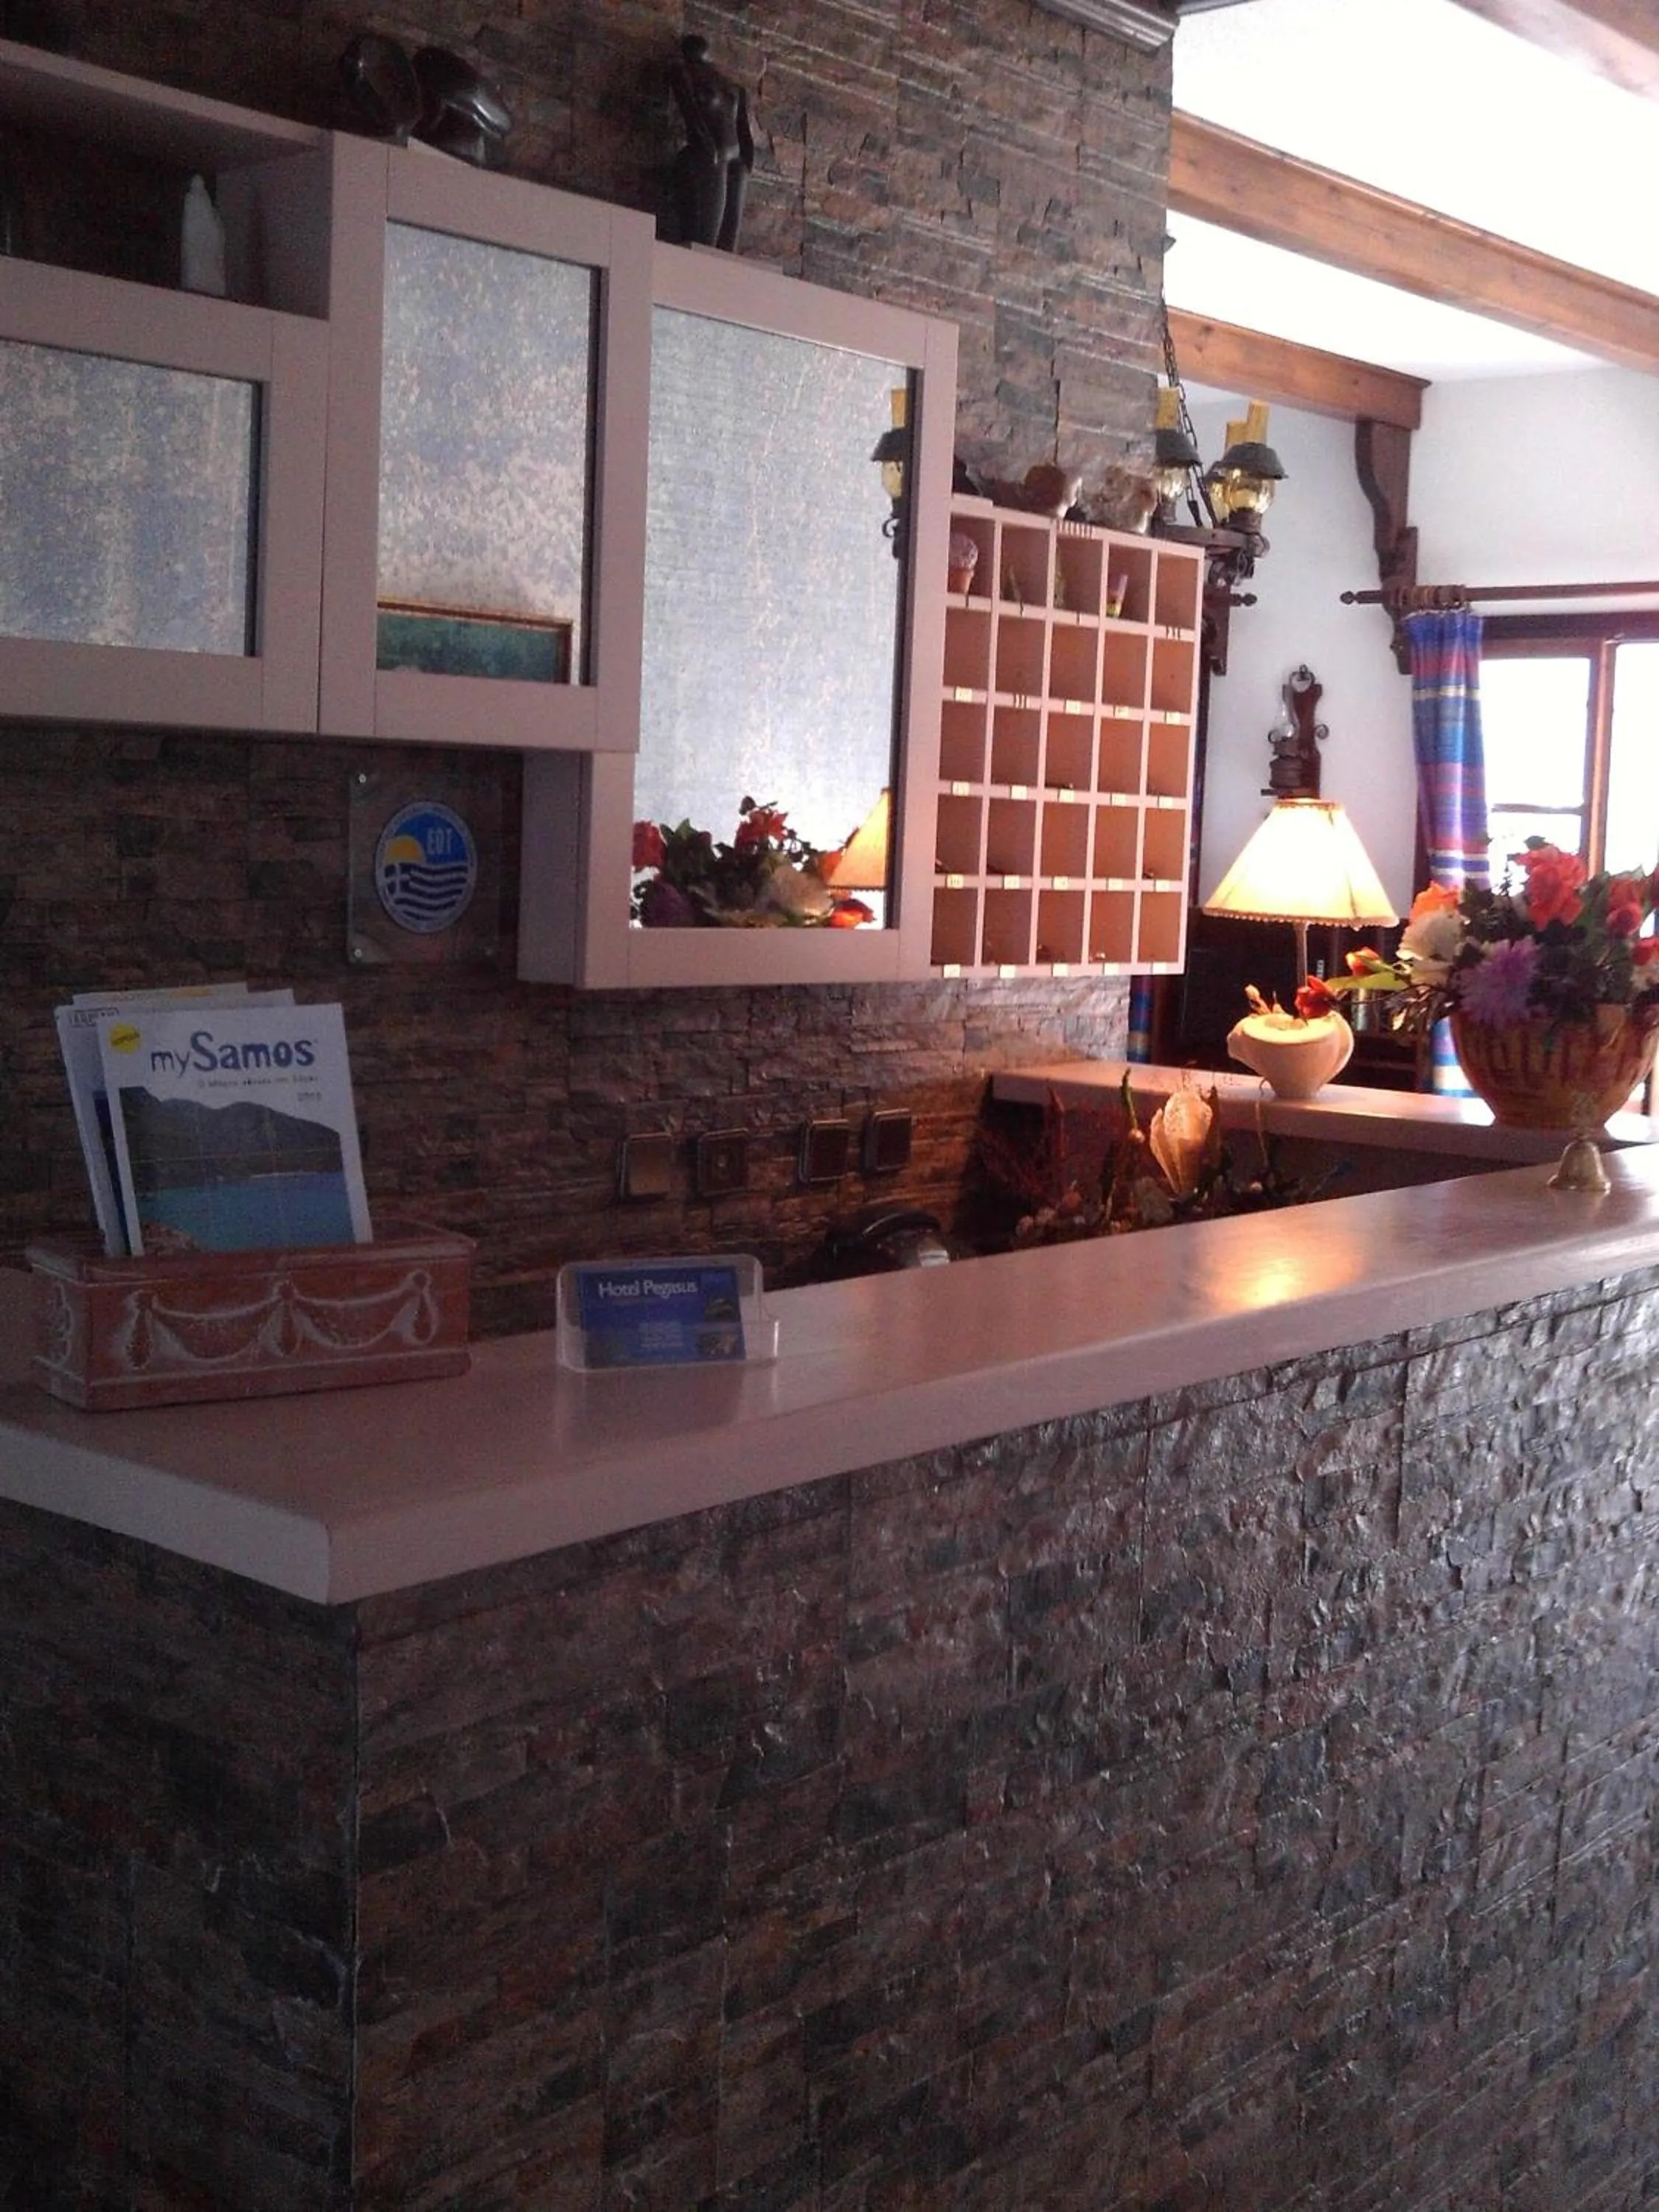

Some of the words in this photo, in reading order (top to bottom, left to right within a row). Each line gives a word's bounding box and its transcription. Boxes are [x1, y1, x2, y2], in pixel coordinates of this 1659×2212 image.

[150, 1031, 316, 1078] mySamos
[598, 1280, 639, 1298] Hotel
[644, 1279, 698, 1299] Pegasus
